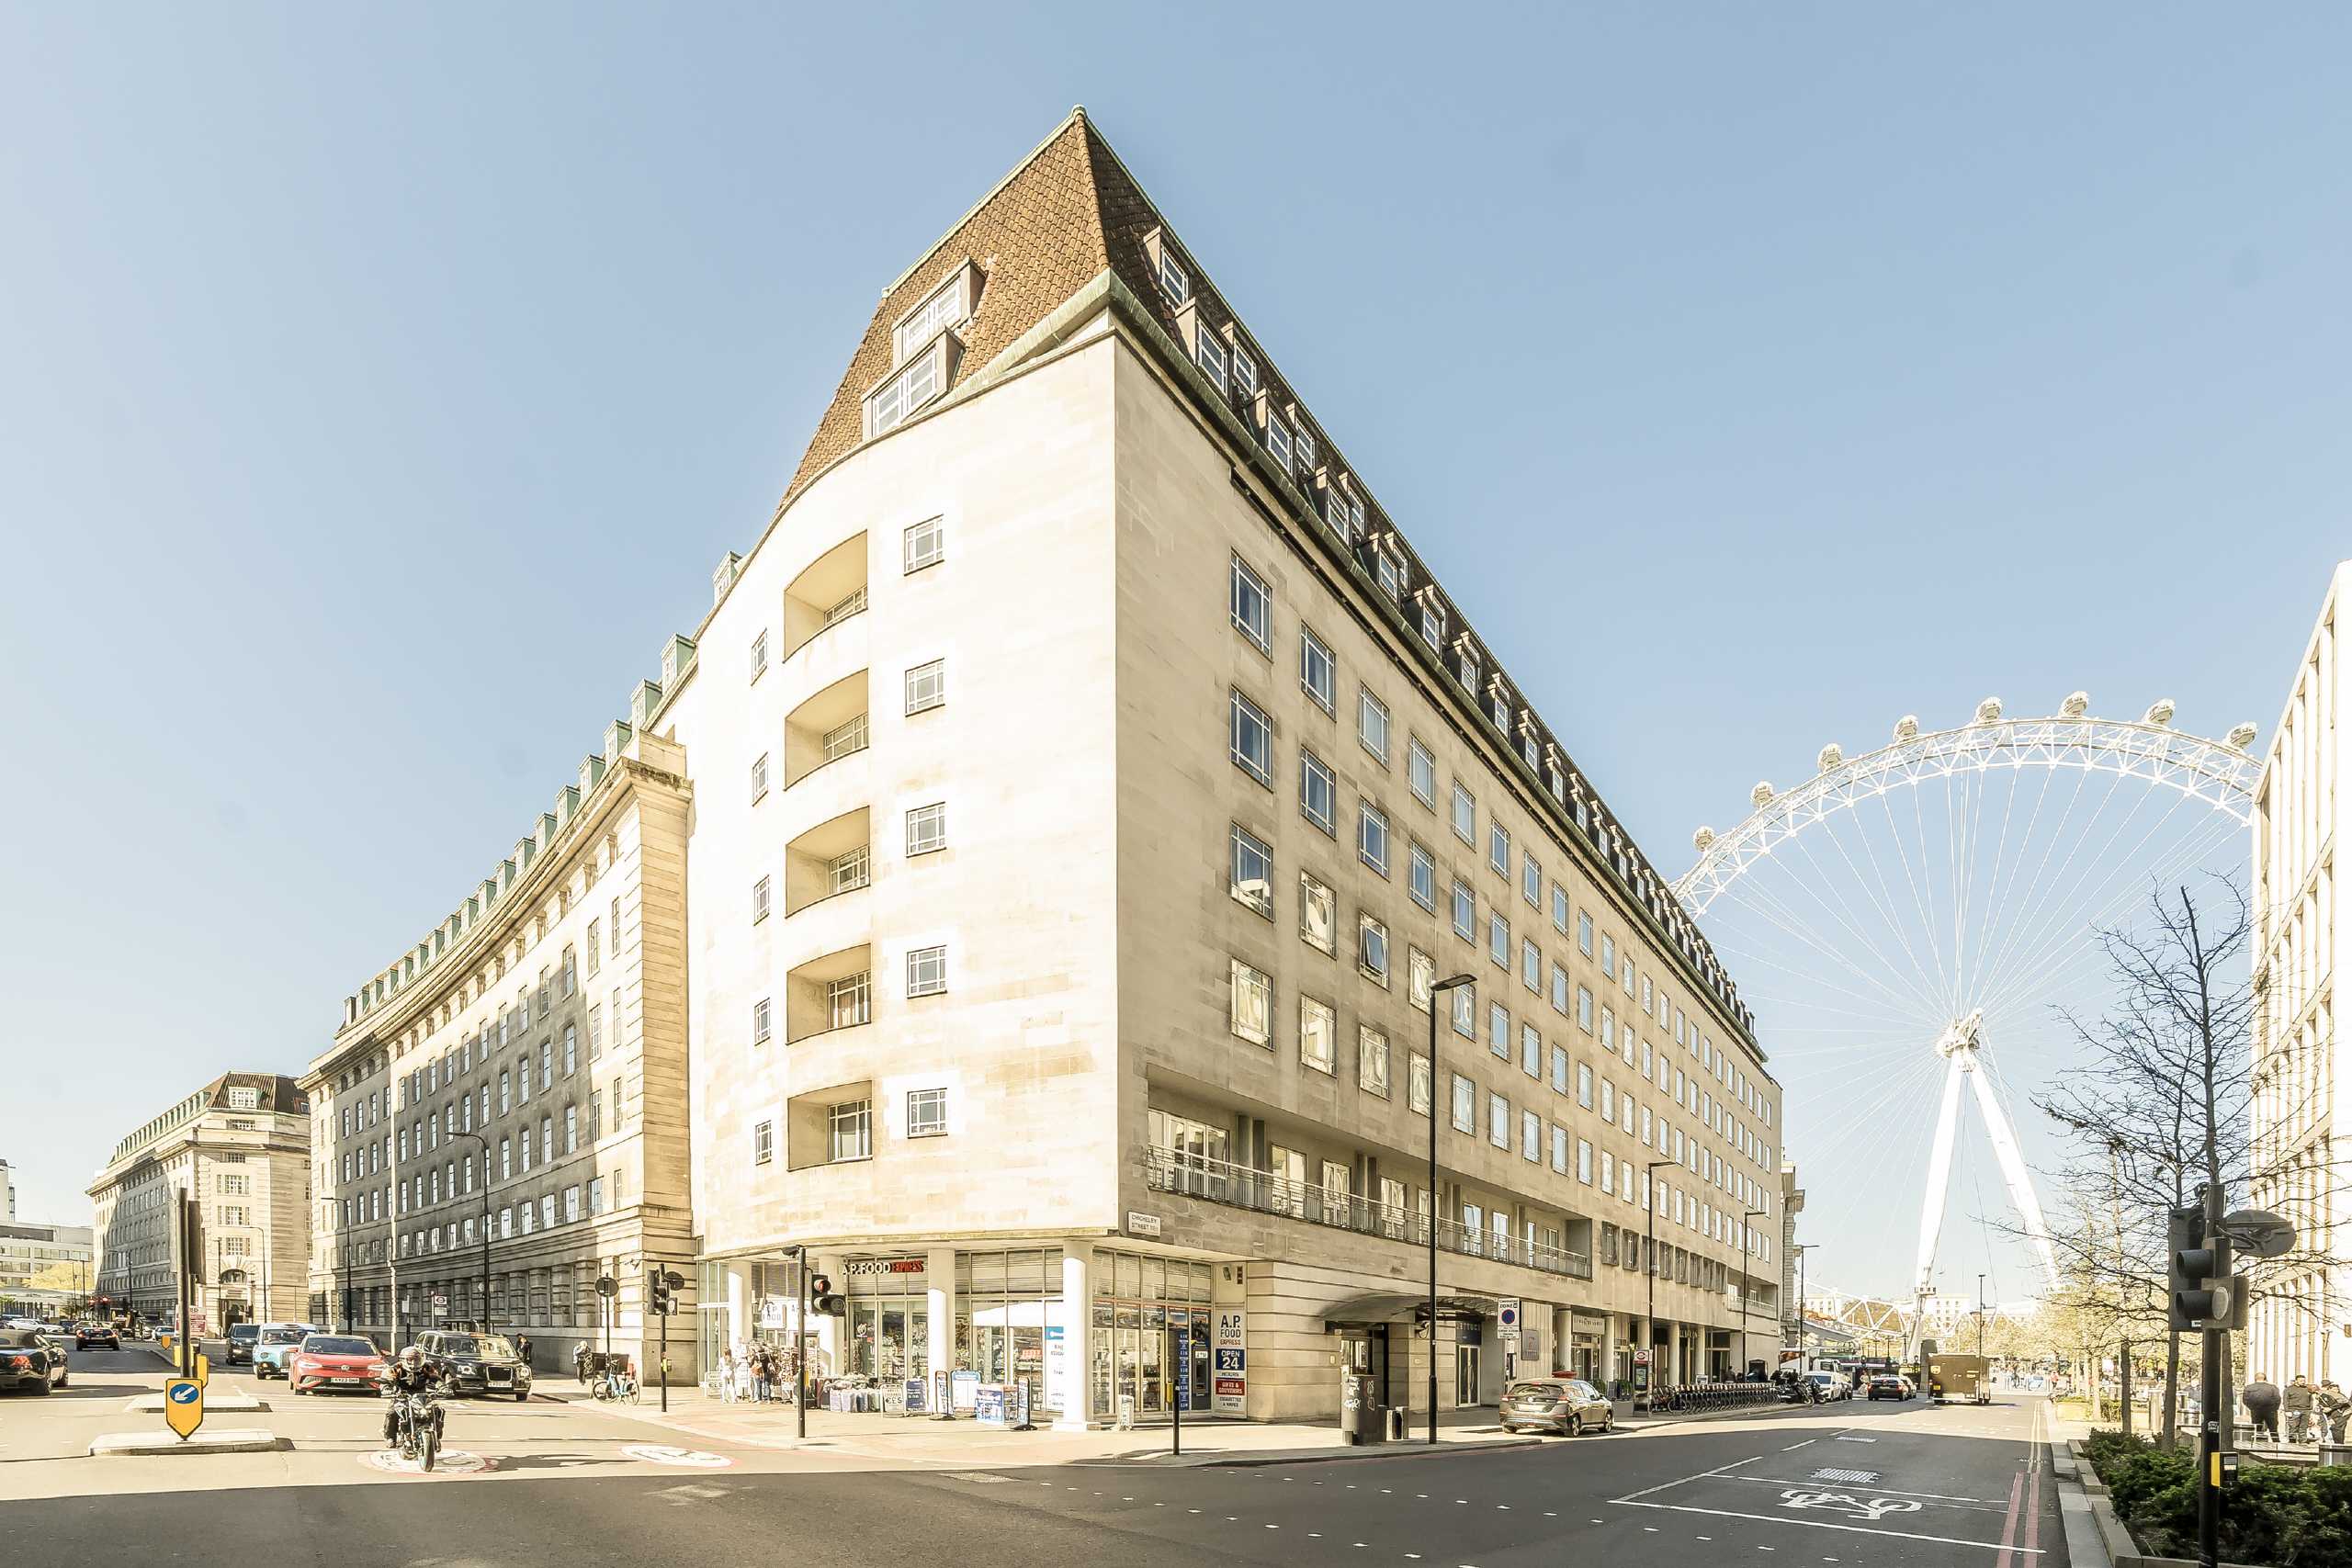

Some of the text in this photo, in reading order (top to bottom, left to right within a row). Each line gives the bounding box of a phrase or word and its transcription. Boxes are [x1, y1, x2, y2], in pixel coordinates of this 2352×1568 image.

[1220, 1315, 1240, 1327] A.P.
[1220, 1329, 1241, 1338] FOOD
[1222, 1358, 1239, 1370] 24
